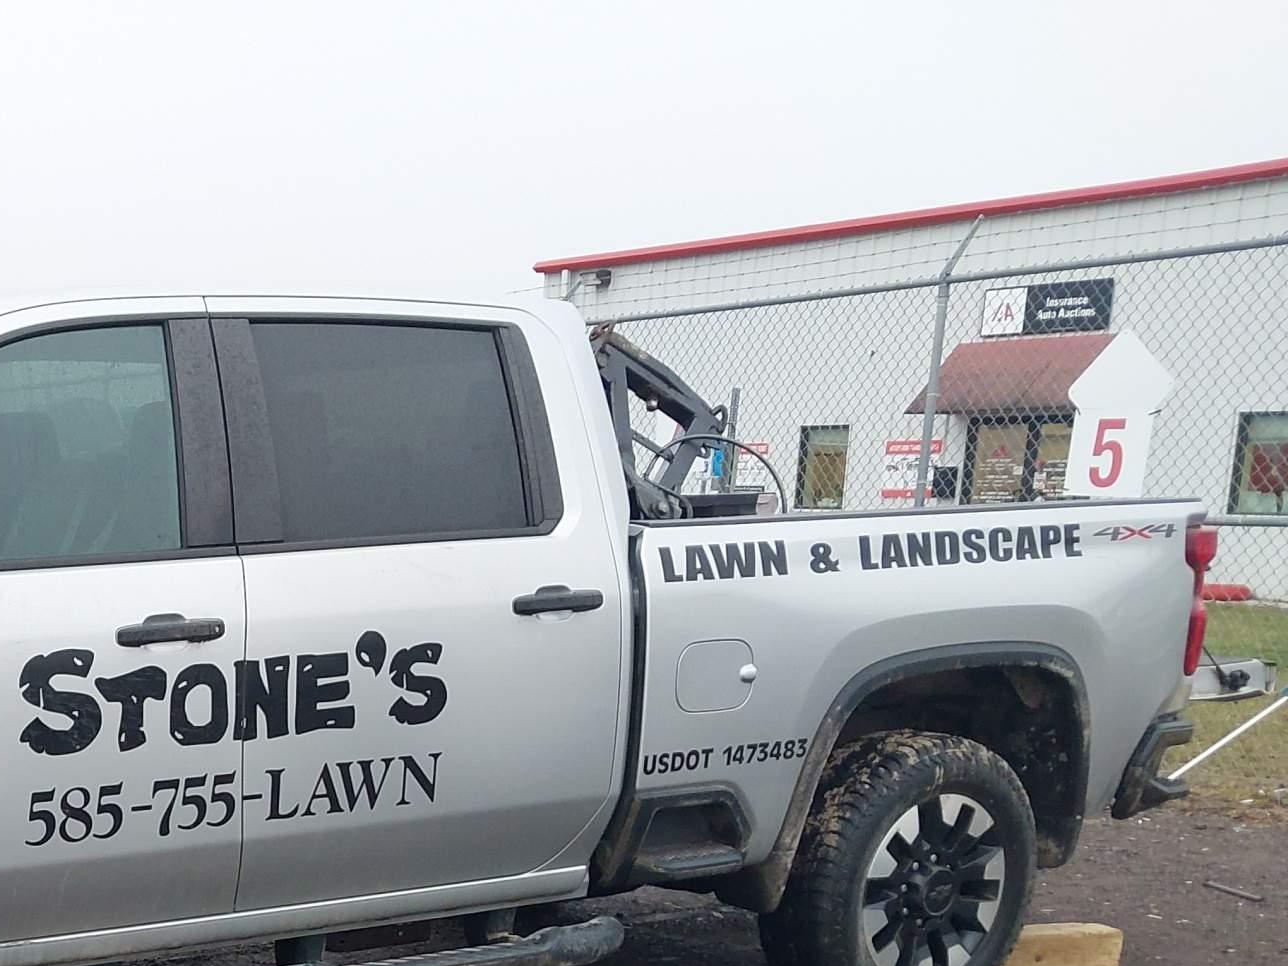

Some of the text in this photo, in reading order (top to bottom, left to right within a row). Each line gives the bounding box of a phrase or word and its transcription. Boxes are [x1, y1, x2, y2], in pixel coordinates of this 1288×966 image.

[1045, 295, 1090, 308] Insurance
[1057, 306, 1097, 318] Auctions
[1089, 418, 1127, 488] 5
[658, 523, 1083, 583] LAWN & LANDSCAPE
[643, 738, 808, 775] USDOT 1473483
[24, 751, 443, 847] 585-755-LAWN
